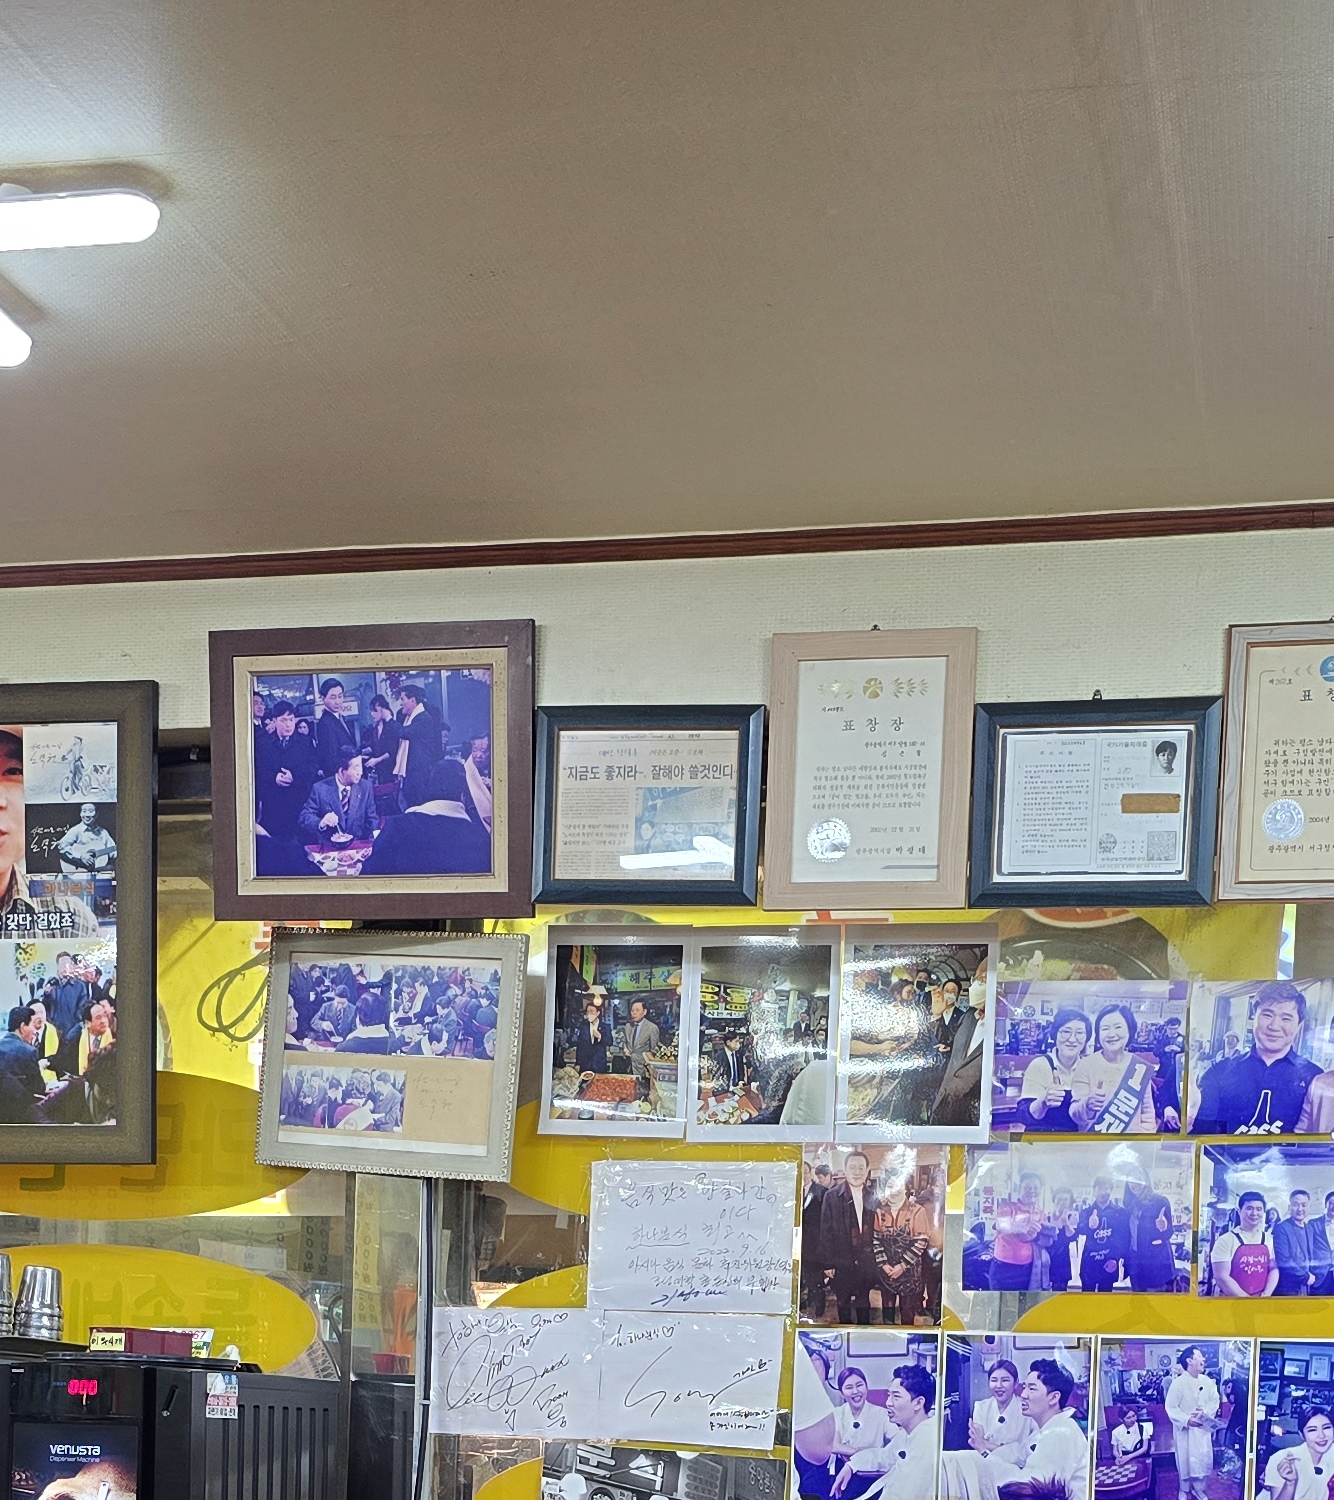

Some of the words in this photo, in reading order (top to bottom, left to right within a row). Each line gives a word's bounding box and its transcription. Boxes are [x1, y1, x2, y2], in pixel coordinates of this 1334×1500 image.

[651, 764, 685, 780] 잘해야
[44, 881, 95, 896] 하나분식
[6, 913, 33, 931] 갖다
[35, 912, 74, 931] 걸었죠
